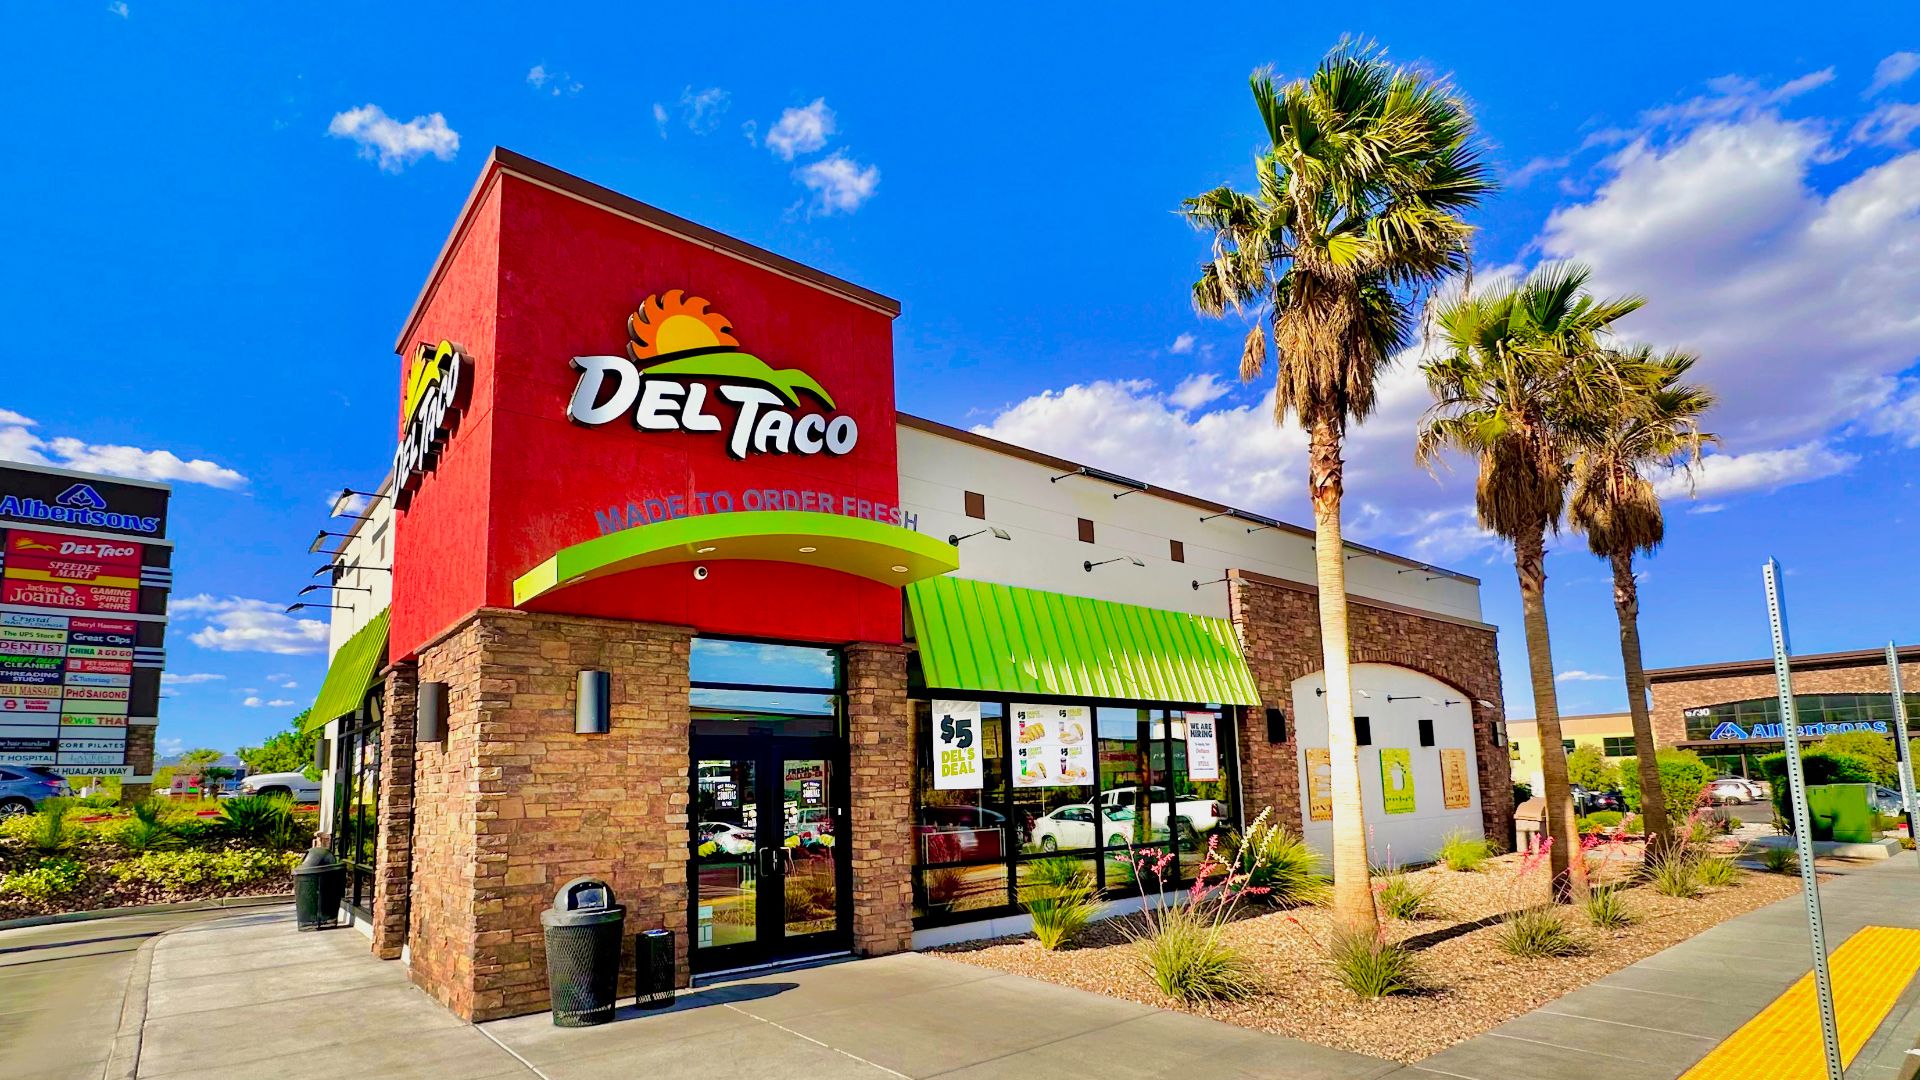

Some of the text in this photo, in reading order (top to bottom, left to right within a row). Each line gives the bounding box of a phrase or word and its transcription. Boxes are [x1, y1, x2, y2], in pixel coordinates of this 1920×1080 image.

[566, 355, 858, 458] DEL TACO
[0, 495, 160, 532] Albertsons
[595, 489, 918, 536] MADE TO ORDER FRESH
[59, 541, 135, 558] DEL TACO
[55, 569, 94, 579] MART
[25, 583, 60, 594] Jackpot
[90, 586, 132, 597] GAMING
[9, 587, 86, 607] Joanie's
[92, 594, 131, 604] SPIRITS
[97, 602, 131, 612] 24HRS
[72, 632, 131, 645] Great Clips
[0, 641, 63, 652] DENTIST
[69, 647, 95, 656] CHINA
[4, 661, 57, 670] CLEANERS
[0, 670, 59, 679] THREADING
[19, 686, 60, 697] MASSAGE
[940, 714, 973, 748] $5
[1190, 730, 1213, 738] HIRING
[941, 747, 976, 763] DEL'S
[941, 761, 976, 777] DEAL
